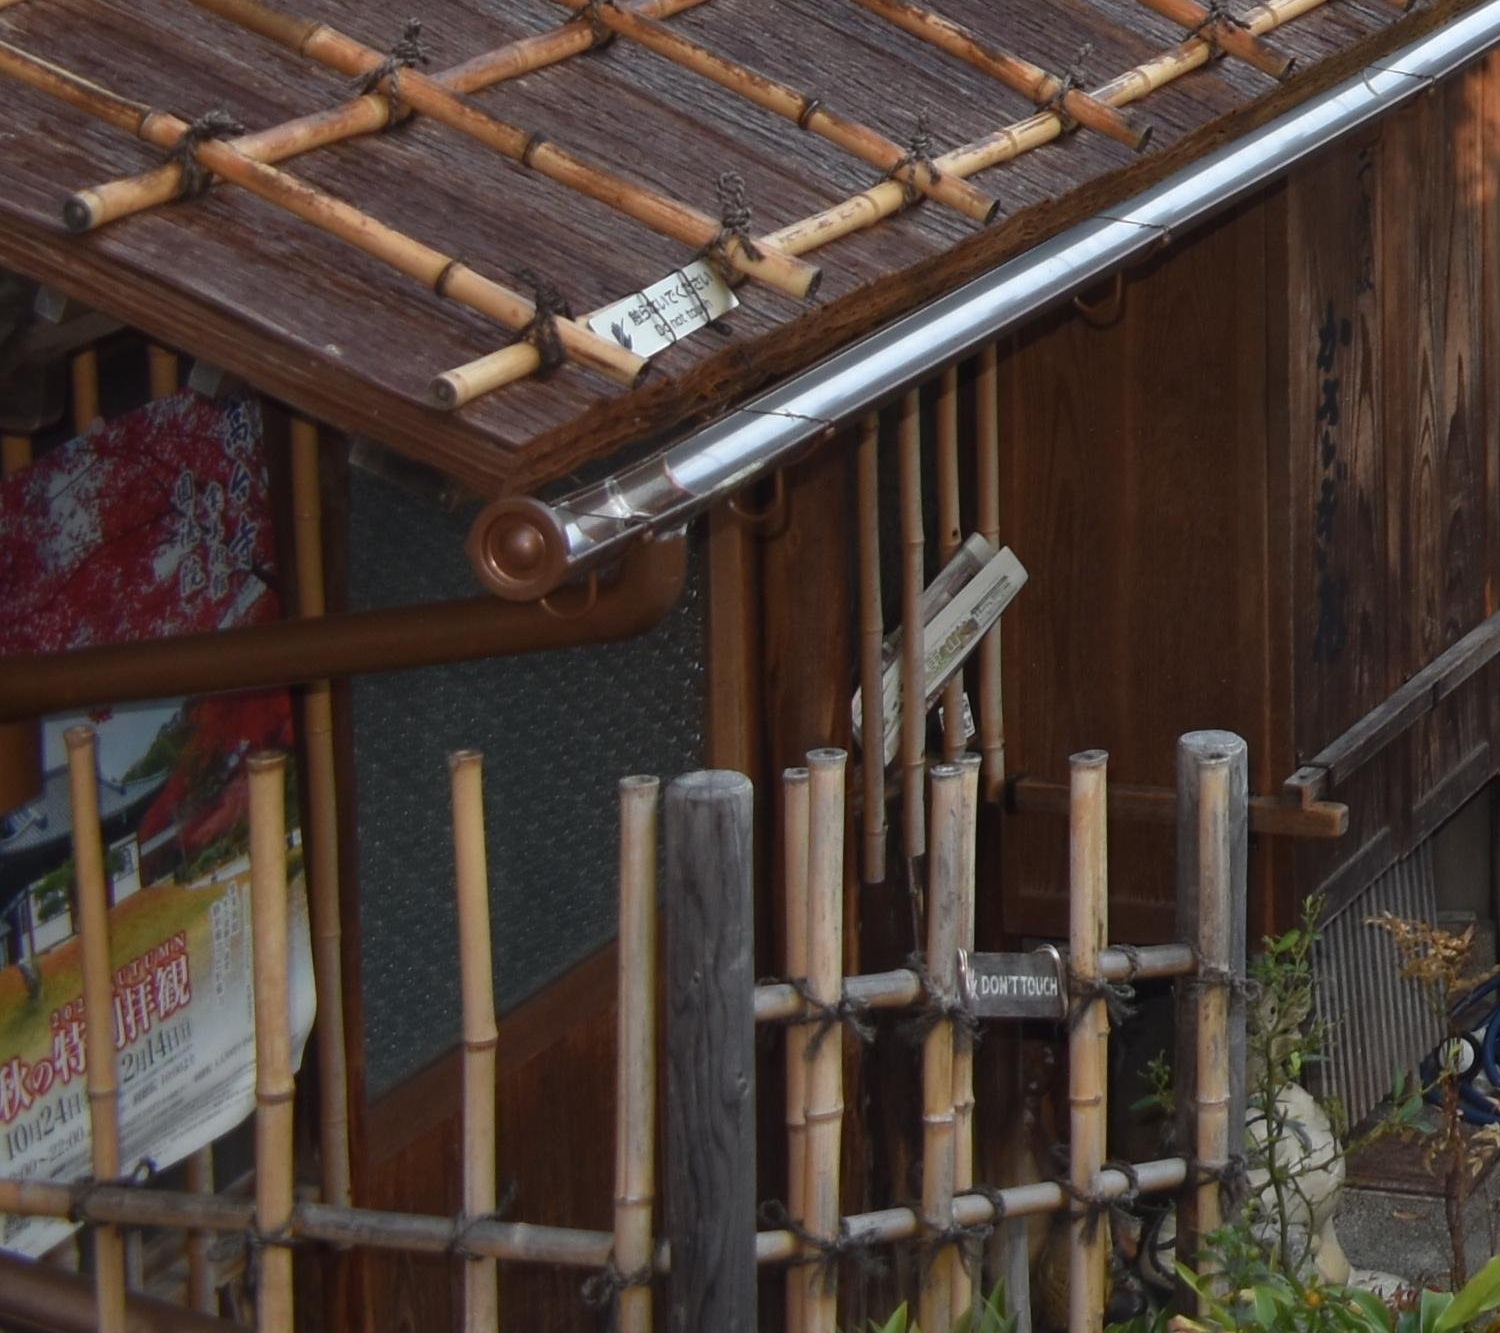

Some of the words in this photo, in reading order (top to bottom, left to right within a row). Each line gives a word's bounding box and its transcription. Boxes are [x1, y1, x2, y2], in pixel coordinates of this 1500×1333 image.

[670, 313, 686, 330] not
[981, 973, 1018, 997] DON'T
[1019, 975, 1058, 997] TOUCH
